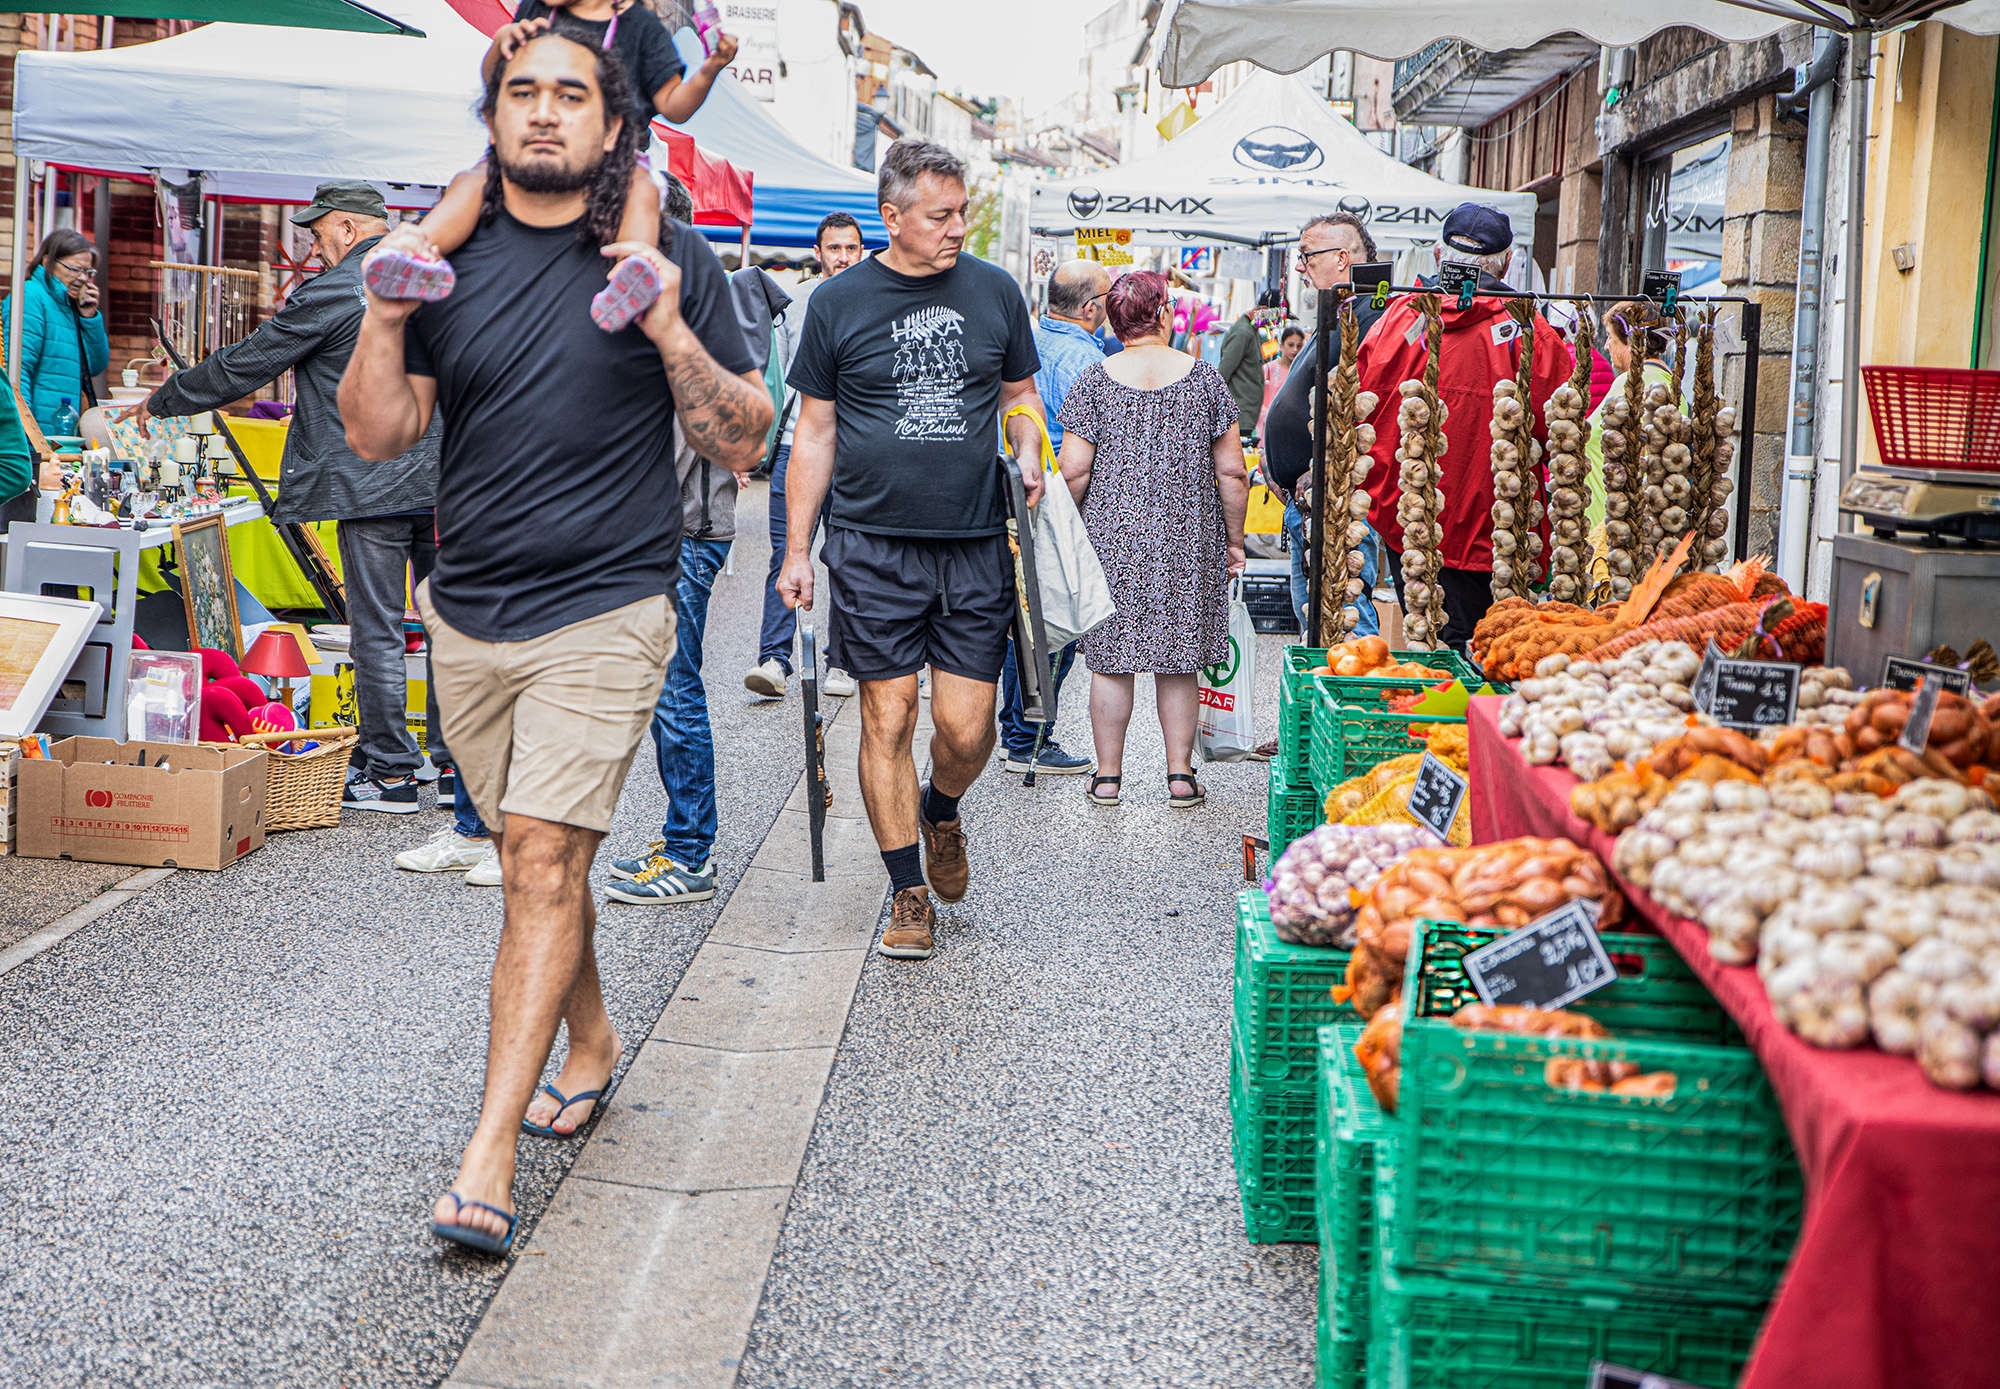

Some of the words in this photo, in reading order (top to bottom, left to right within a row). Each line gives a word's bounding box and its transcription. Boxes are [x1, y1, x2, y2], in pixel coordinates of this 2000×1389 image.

[727, 5, 776, 20] BRASSERIE
[1106, 195, 1215, 215] 24MX
[1374, 205, 1455, 224] 24M
[1075, 227, 1112, 239] MIEL
[895, 418, 921, 436] New
[918, 418, 968, 437] Zealand
[114, 793, 154, 802] COMPAGNIE
[116, 800, 151, 809] FRUITIERE
